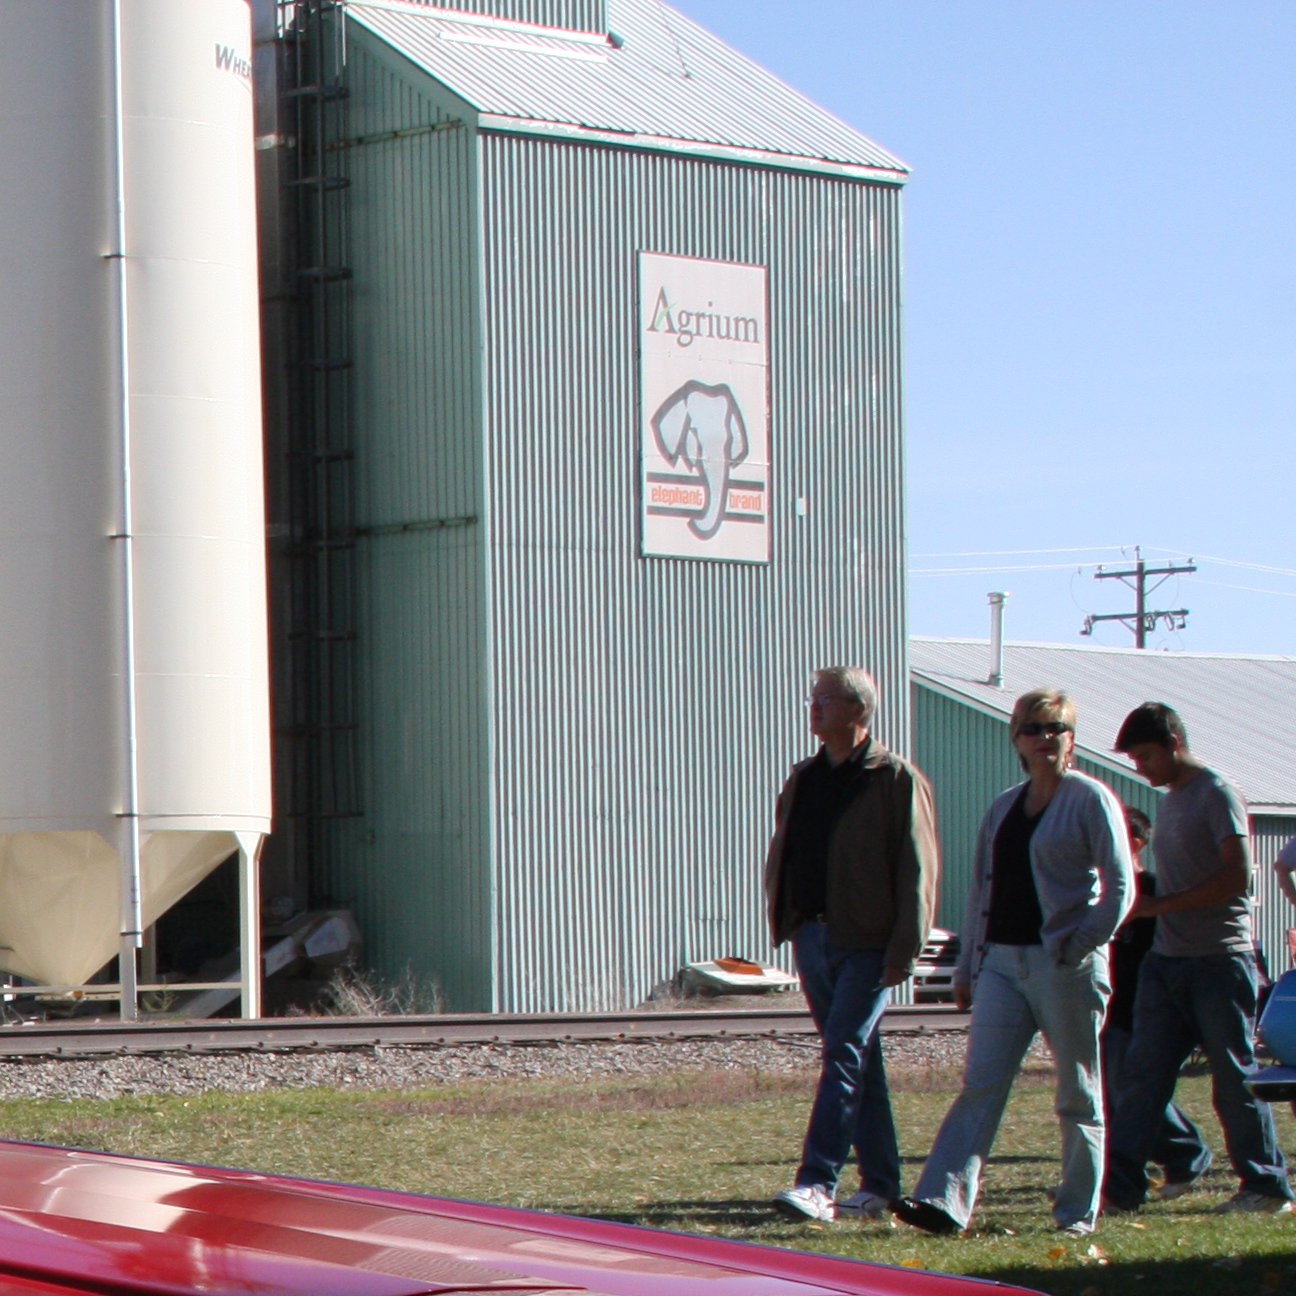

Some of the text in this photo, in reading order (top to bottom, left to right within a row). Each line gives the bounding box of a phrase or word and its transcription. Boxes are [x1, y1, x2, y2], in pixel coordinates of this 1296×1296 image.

[647, 286, 761, 347] Agrium
[651, 485, 761, 511] elephant brand
